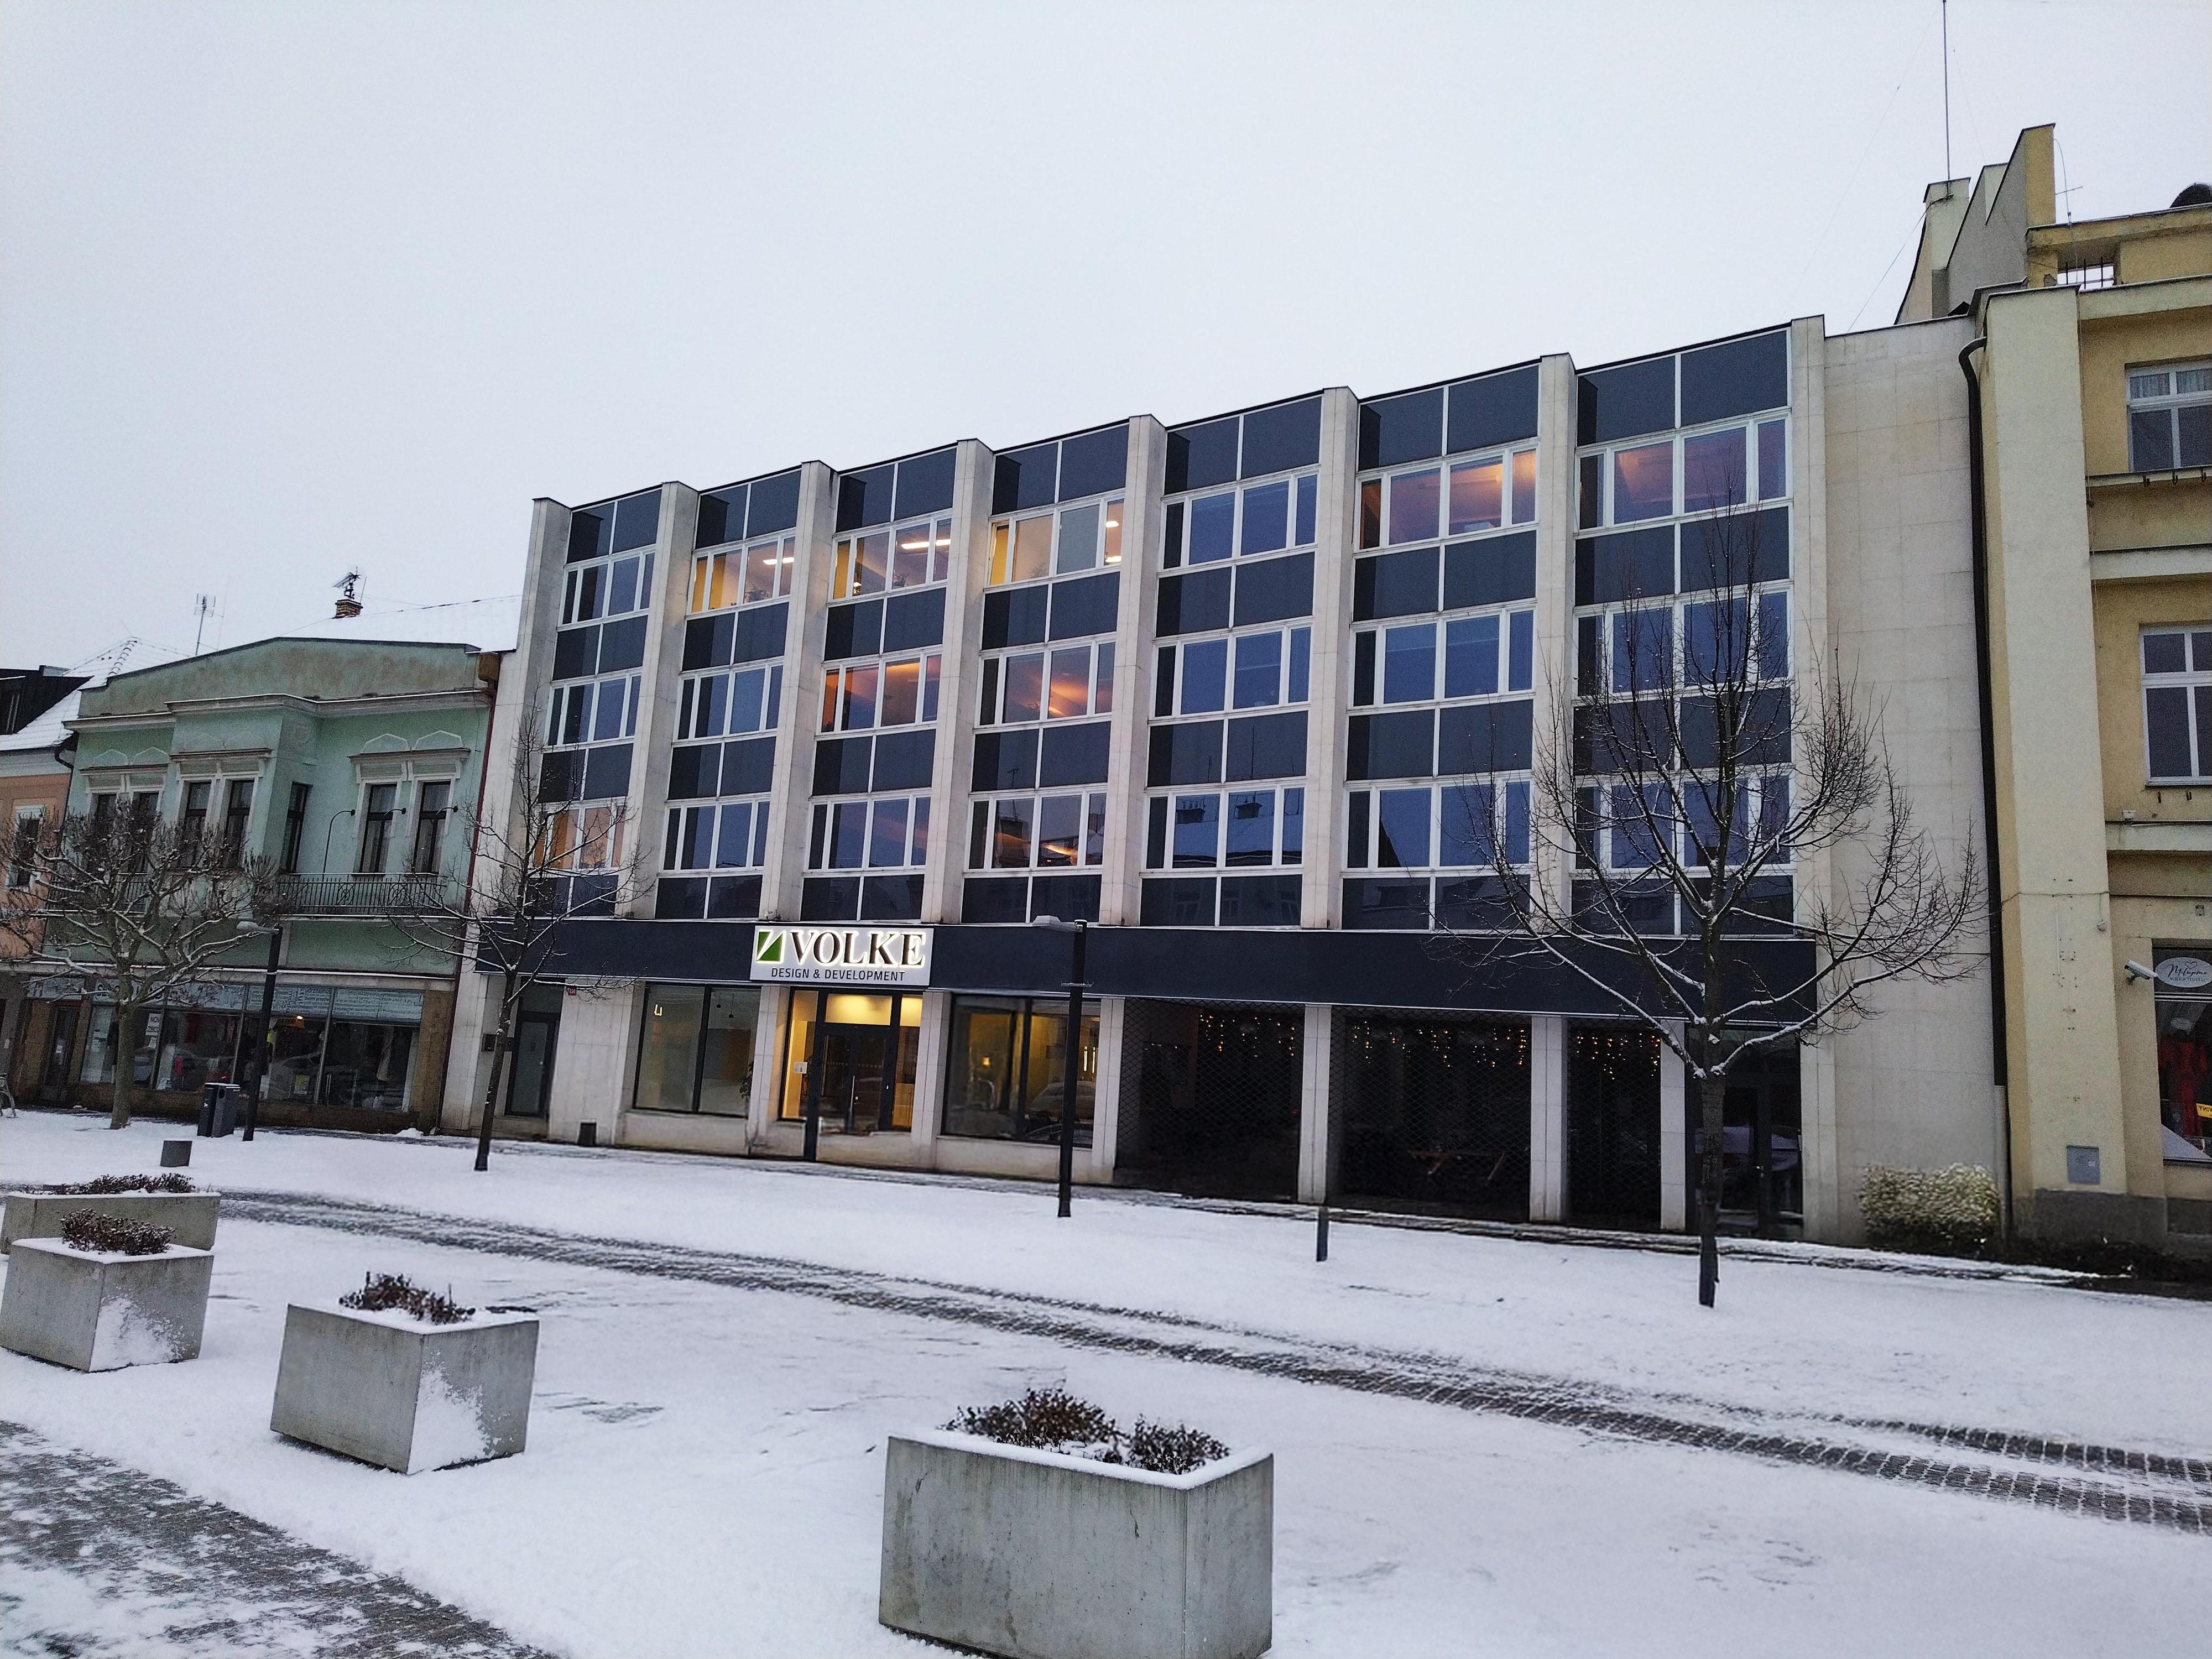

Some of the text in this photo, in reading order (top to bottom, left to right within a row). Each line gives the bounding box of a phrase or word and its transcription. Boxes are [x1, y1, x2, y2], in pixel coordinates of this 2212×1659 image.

[789, 931, 924, 966] VOLKE
[771, 968, 906, 982] DESIGN & DEVELOPMENT
